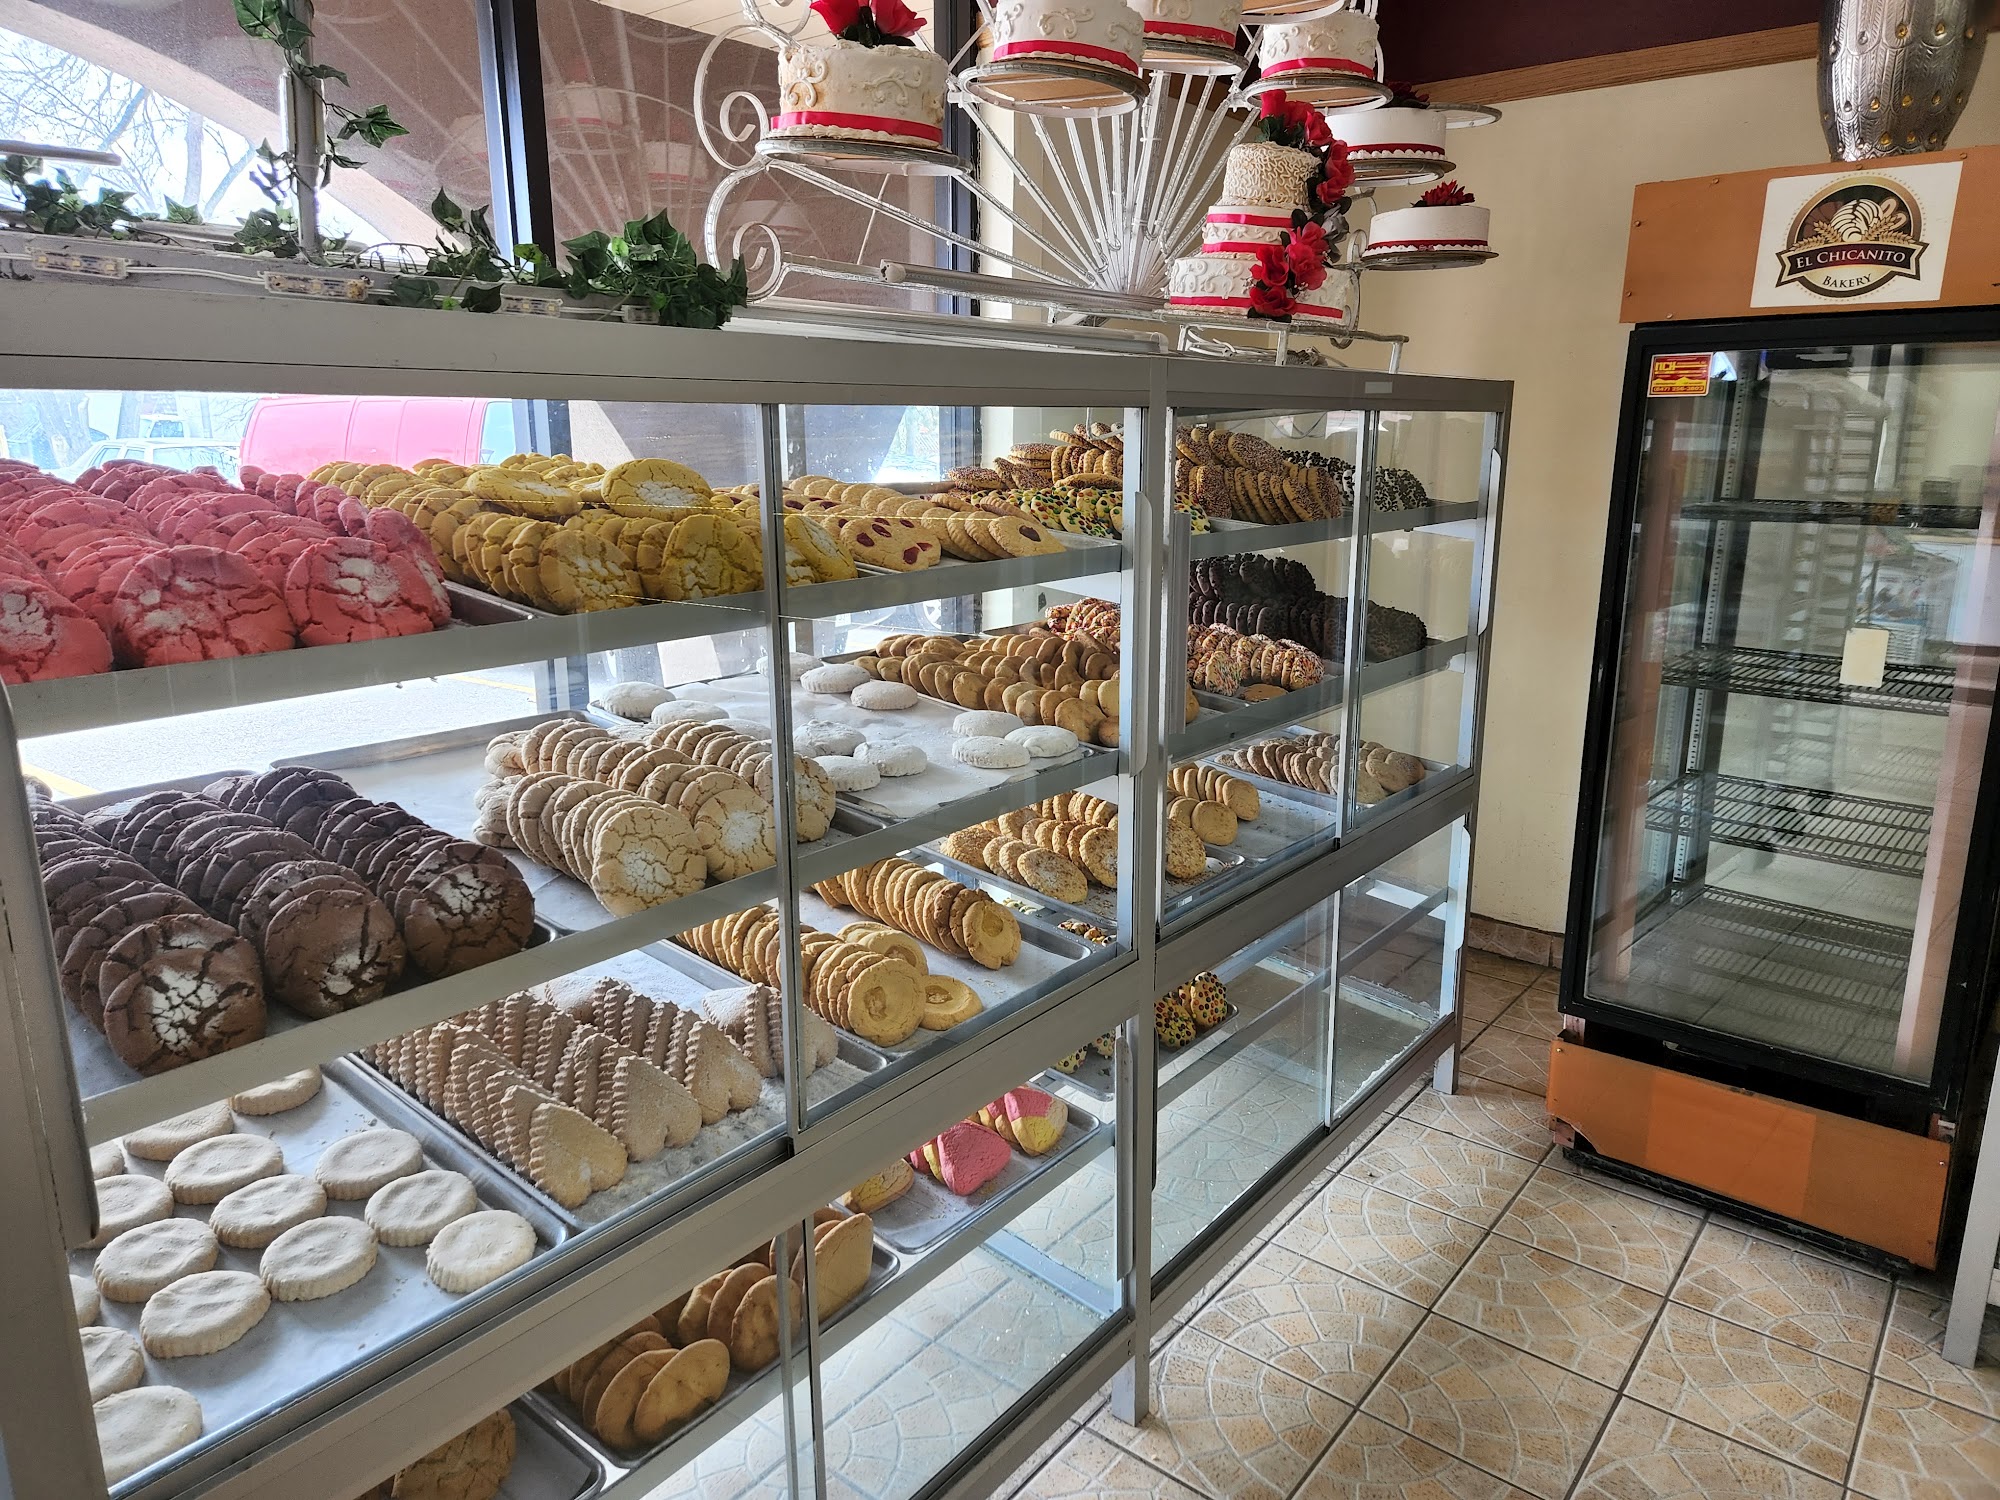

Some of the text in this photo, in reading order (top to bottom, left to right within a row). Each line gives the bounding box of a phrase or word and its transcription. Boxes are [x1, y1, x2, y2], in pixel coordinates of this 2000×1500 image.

[1796, 249, 1906, 269] EL CHICANITO
[1822, 273, 1873, 289] BAKERY
